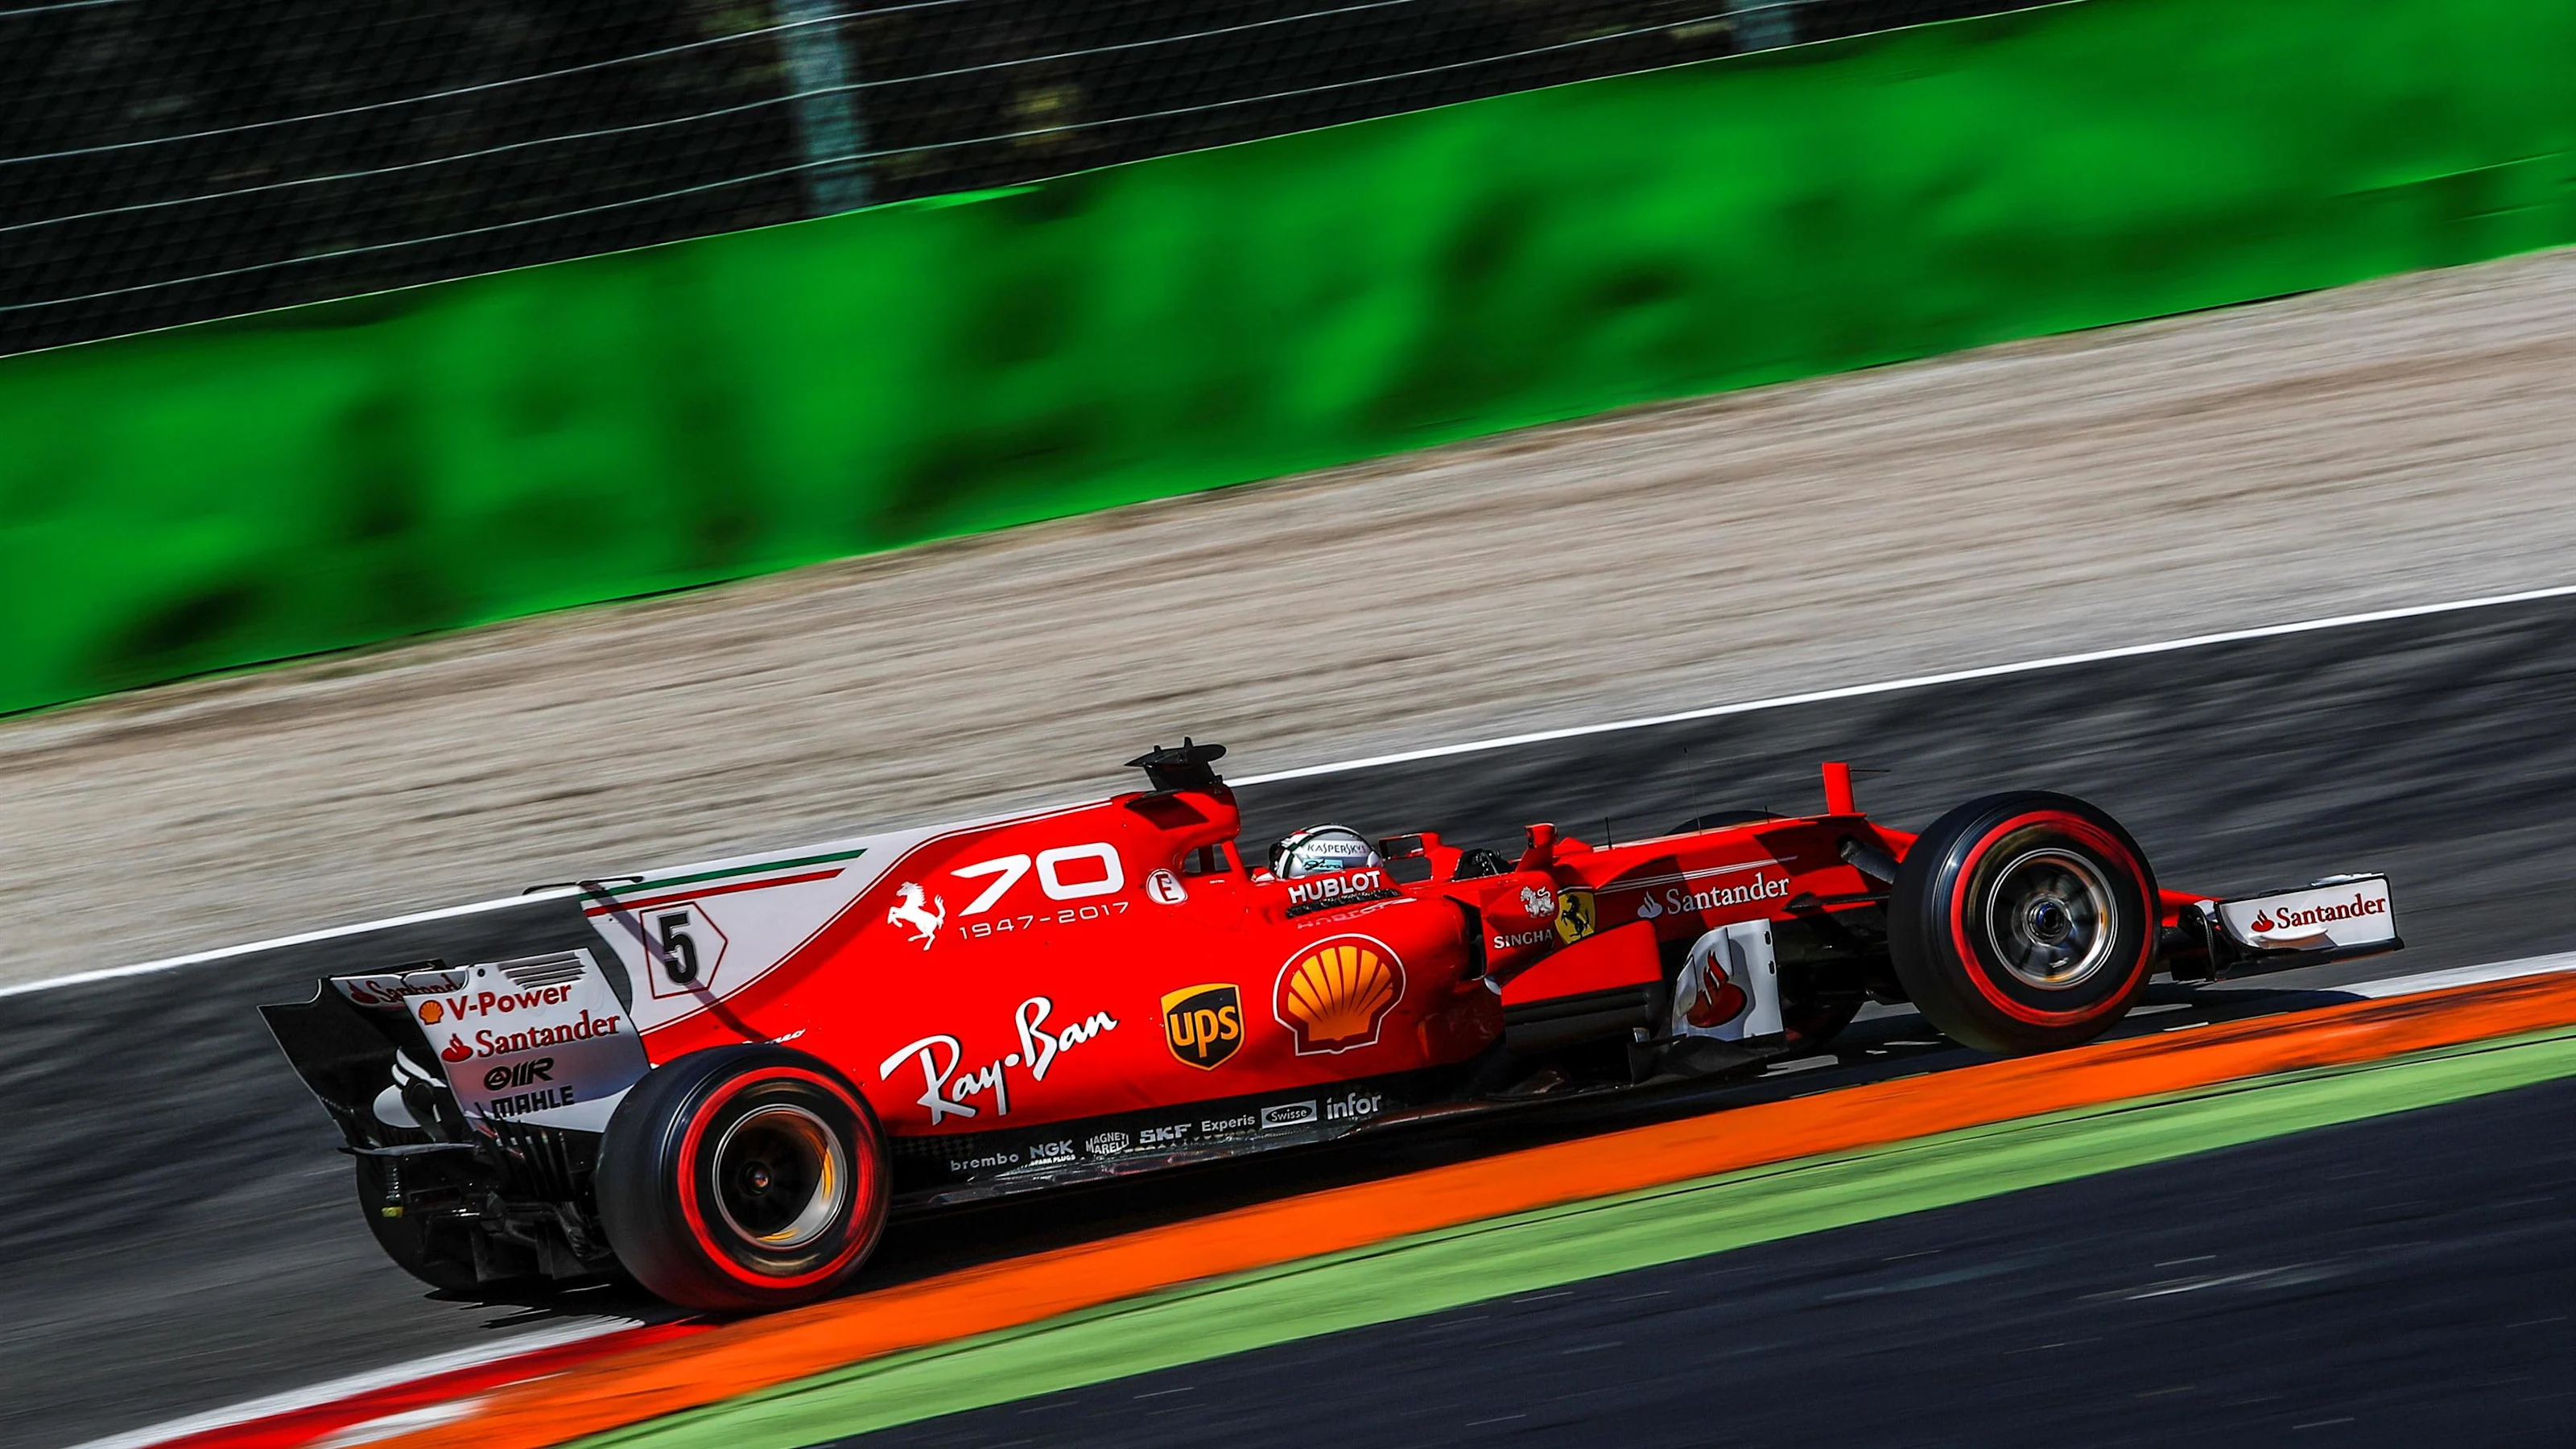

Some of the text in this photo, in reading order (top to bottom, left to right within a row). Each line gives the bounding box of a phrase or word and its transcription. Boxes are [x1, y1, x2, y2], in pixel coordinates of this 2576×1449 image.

[950, 842, 1125, 917] 70
[1155, 873, 1179, 902] E
[1288, 870, 1381, 904] HUBLOT
[1666, 872, 1790, 915] Santander
[958, 901, 1129, 940] 1947-2017
[2276, 893, 2386, 929] Santander
[657, 910, 699, 985] 5
[1494, 929, 1554, 949] SINGHA
[447, 984, 572, 1021] V-Power
[475, 1009, 621, 1059] Santander
[491, 1085, 575, 1120] MAHLE
[1271, 1107, 1308, 1123] Swisse
[1327, 1092, 1382, 1121] infor
[1140, 1123, 1191, 1144] SKF
[1201, 1114, 1256, 1133] Experis
[950, 1153, 1020, 1171] brembo
[1030, 1139, 1074, 1159] NGK
[1053, 1154, 1076, 1163] PLUGS
